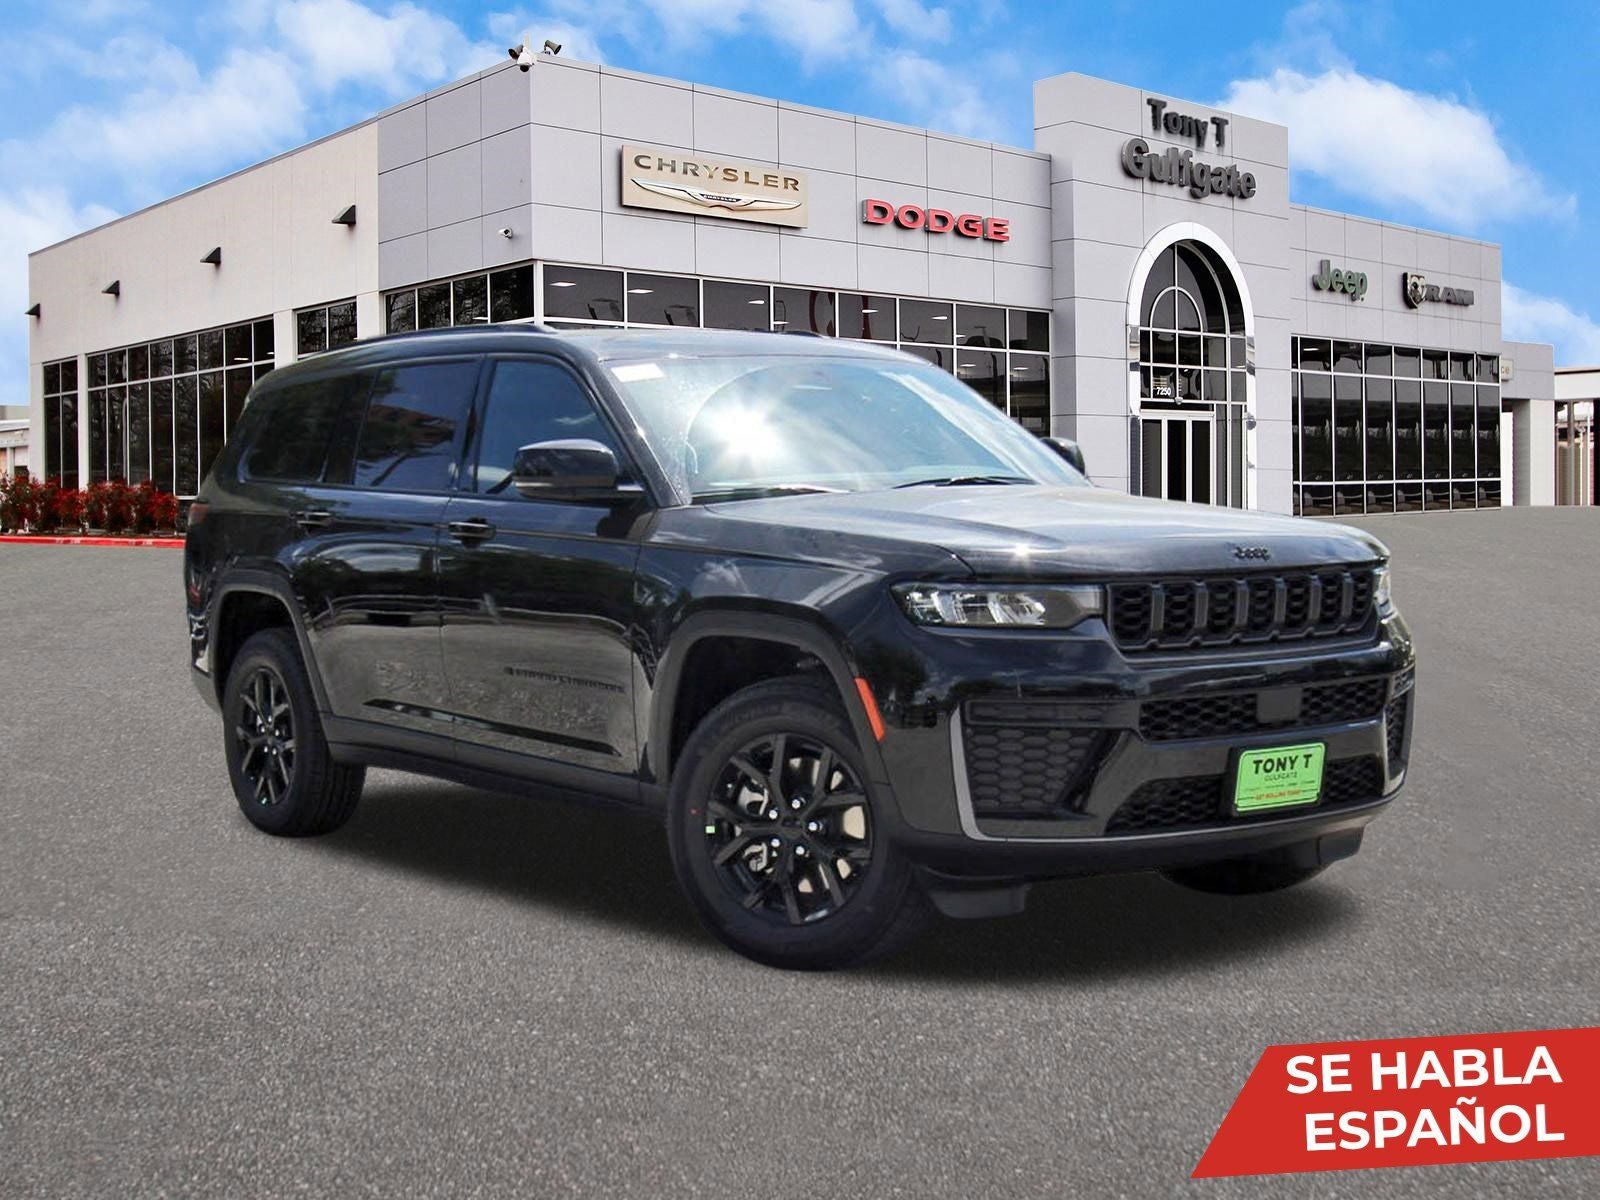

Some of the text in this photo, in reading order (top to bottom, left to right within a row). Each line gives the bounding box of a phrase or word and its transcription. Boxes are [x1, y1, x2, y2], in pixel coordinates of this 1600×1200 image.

[1147, 98, 1229, 148] Tony T
[633, 153, 800, 192] CHRYSLER
[1121, 137, 1257, 199] Gulfgate
[862, 198, 1011, 242] DODGE
[1312, 259, 1368, 302] Jeep
[1425, 283, 1475, 307] RAM
[1156, 386, 1172, 396] 7250
[1252, 753, 1313, 774] TONY T
